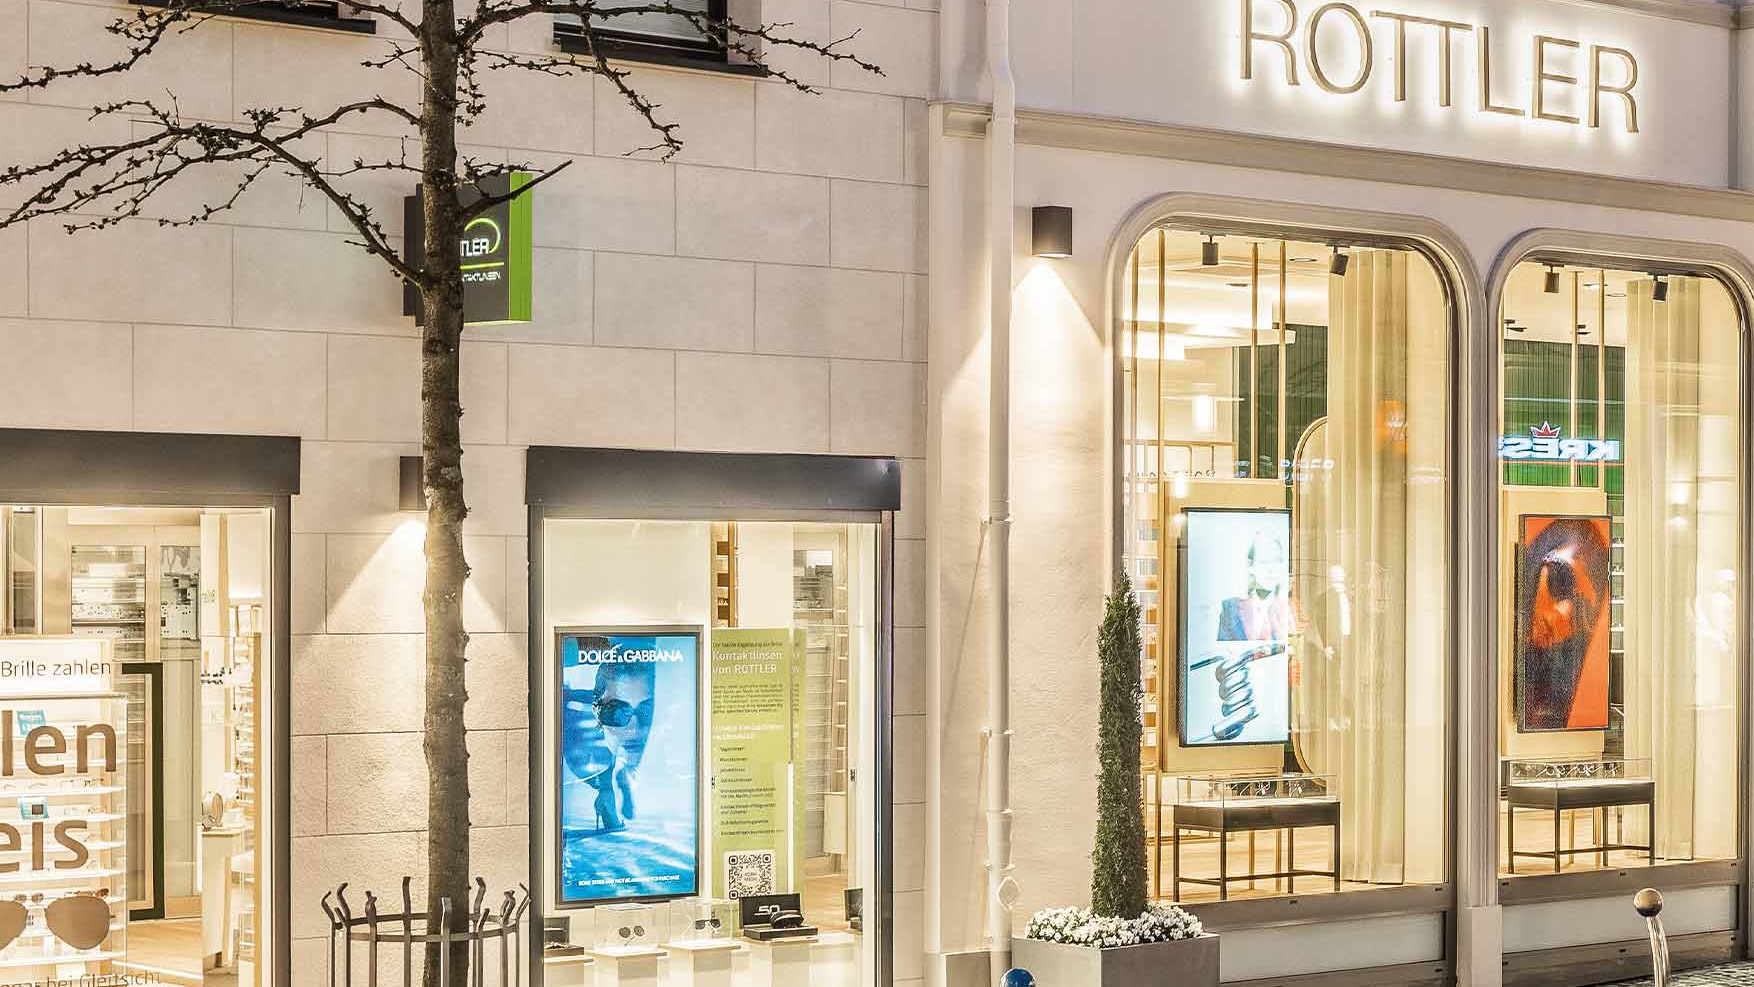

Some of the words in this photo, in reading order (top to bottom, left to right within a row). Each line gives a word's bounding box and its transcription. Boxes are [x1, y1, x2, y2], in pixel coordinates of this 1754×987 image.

[712, 650, 783, 662] Kontaktlinsen
[1, 660, 46, 678] Brille
[53, 660, 112, 677] zahlen
[712, 666, 732, 674] von
